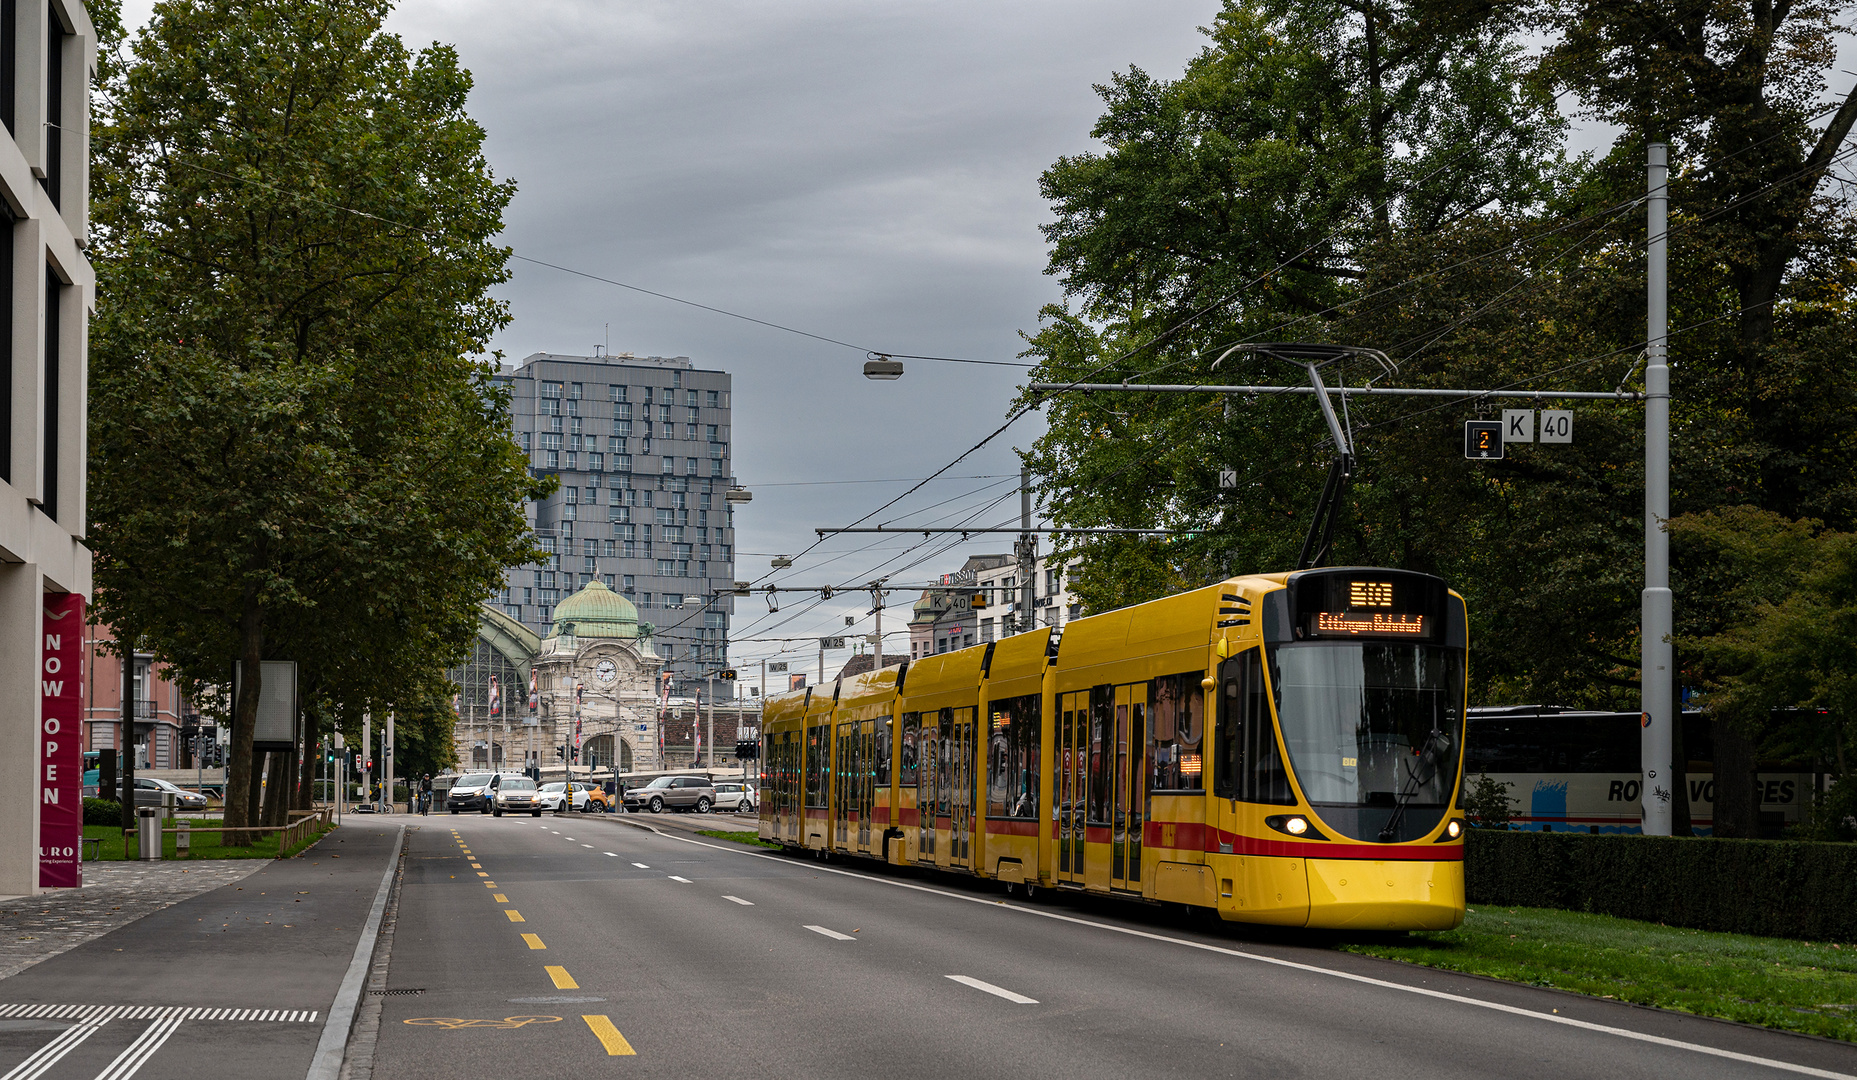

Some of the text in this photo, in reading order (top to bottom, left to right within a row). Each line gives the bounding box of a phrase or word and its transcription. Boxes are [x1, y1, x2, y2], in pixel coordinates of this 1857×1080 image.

[1510, 415, 1569, 437] K 40
[1479, 431, 1489, 449] 2
[1222, 472, 1234, 487] K
[934, 597, 966, 609] K 40
[846, 617, 854, 625] K
[821, 638, 844, 648] W 25
[42, 633, 63, 697] NOW
[778, 663, 787, 671] 25
[44, 717, 61, 805] OPEN
